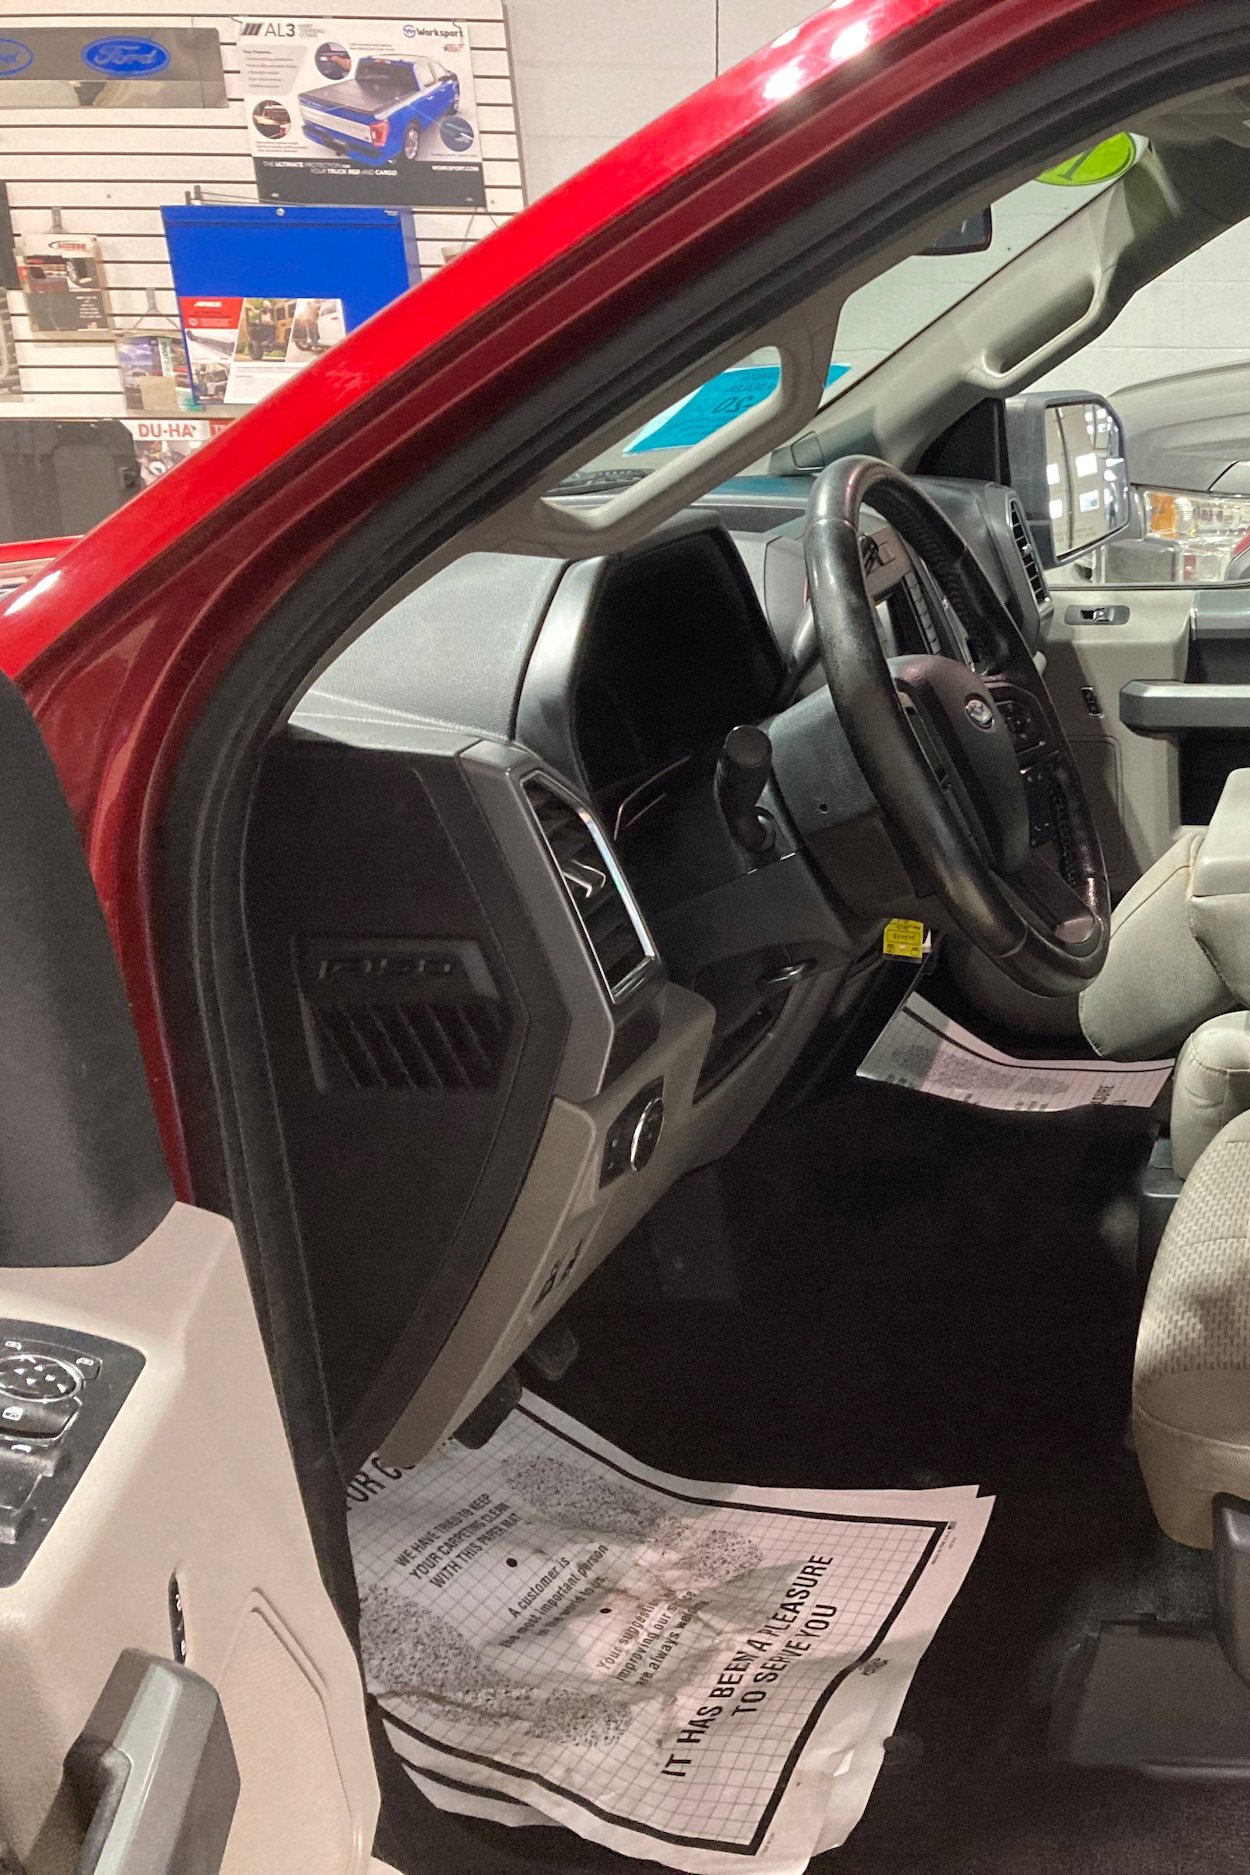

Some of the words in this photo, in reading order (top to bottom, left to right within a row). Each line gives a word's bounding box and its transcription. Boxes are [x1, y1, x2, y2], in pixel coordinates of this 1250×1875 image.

[264, 22, 296, 37] AL3
[415, 28, 464, 38] Worksport
[93, 44, 158, 65] Ford
[138, 423, 194, 438] DU-HA
[346, 1471, 386, 1511] UR
[394, 1549, 417, 1567] WE
[412, 1532, 440, 1553] HAVE
[458, 1507, 474, 1520] TO
[469, 1493, 492, 1512] KEEP
[409, 1552, 444, 1580] YOUR
[437, 1519, 486, 1555] CARPETING
[481, 1501, 511, 1523] CLEAN
[429, 1561, 463, 1589] WITH
[455, 1543, 483, 1563] THIS
[477, 1526, 508, 1546] PAPER
[501, 1512, 523, 1528] MAT
[508, 1607, 521, 1618] A
[517, 1566, 560, 1610] customer
[558, 1557, 571, 1569] is
[534, 1574, 580, 1615] important
[577, 1544, 609, 1578] person
[757, 1554, 834, 1637] PLEASURE
[596, 1646, 625, 1670] Your
[614, 1632, 660, 1682] improving
[654, 1613, 672, 1630] our
[635, 1670, 654, 1687] are
[649, 1631, 680, 1670] always
[731, 1690, 767, 1717] TO
[752, 1636, 812, 1684] SERVE
[802, 1604, 838, 1638] YOU
[746, 1638, 772, 1653] A
[708, 1650, 760, 1699] BEEN
[676, 1705, 723, 1743] HAS
[661, 1753, 692, 1777] IT
